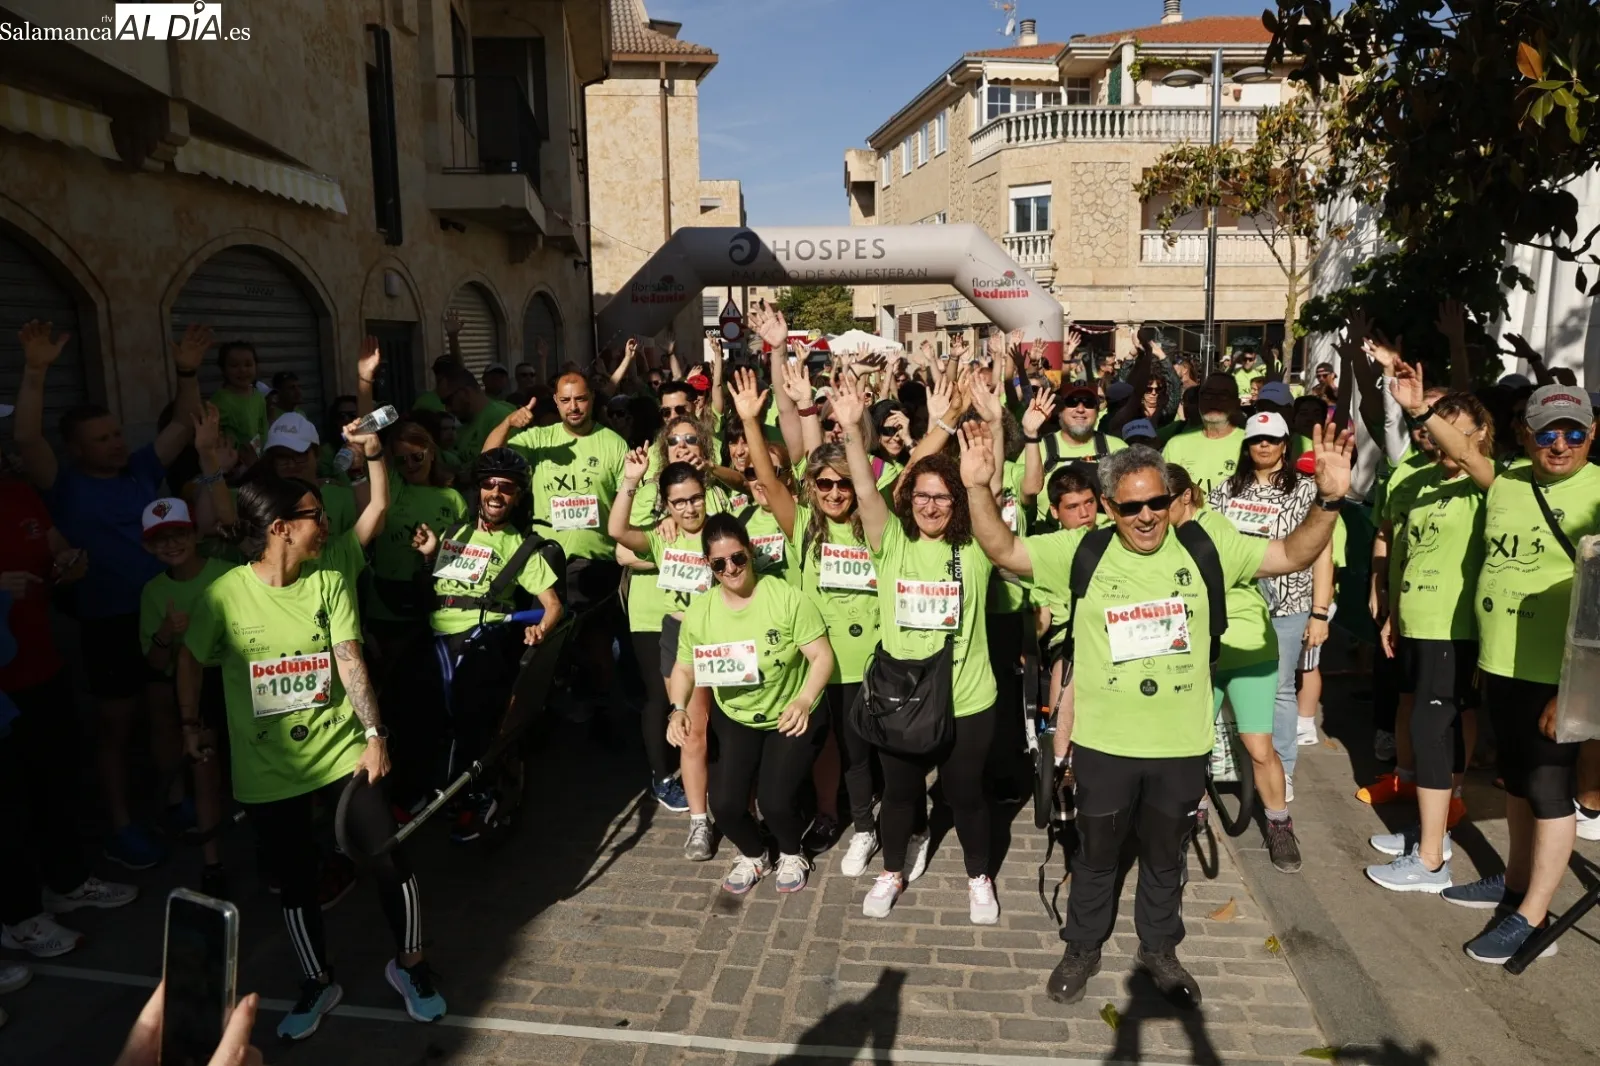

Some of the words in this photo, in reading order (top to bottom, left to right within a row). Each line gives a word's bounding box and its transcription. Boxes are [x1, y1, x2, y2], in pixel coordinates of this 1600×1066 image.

[772, 238, 886, 261] HOSPES
[731, 269, 799, 281] PALACIO
[805, 268, 825, 279] DE
[829, 268, 860, 279] SAN
[865, 267, 928, 278] ESTEBAN
[973, 287, 1029, 299] bedunia
[552, 497, 596, 508] bedunia
[1230, 499, 1279, 515] bedunia
[561, 507, 590, 520] 1067
[1236, 510, 1268, 524] 1222
[442, 540, 491, 559] bedunia
[449, 554, 477, 571] 1066
[834, 560, 872, 577] 1009
[671, 563, 703, 581] 1427
[896, 581, 958, 597] bedunia
[909, 597, 949, 615] 1013
[1106, 601, 1184, 625] bedunia
[252, 656, 329, 678] bedunia
[268, 673, 318, 697] 1068
